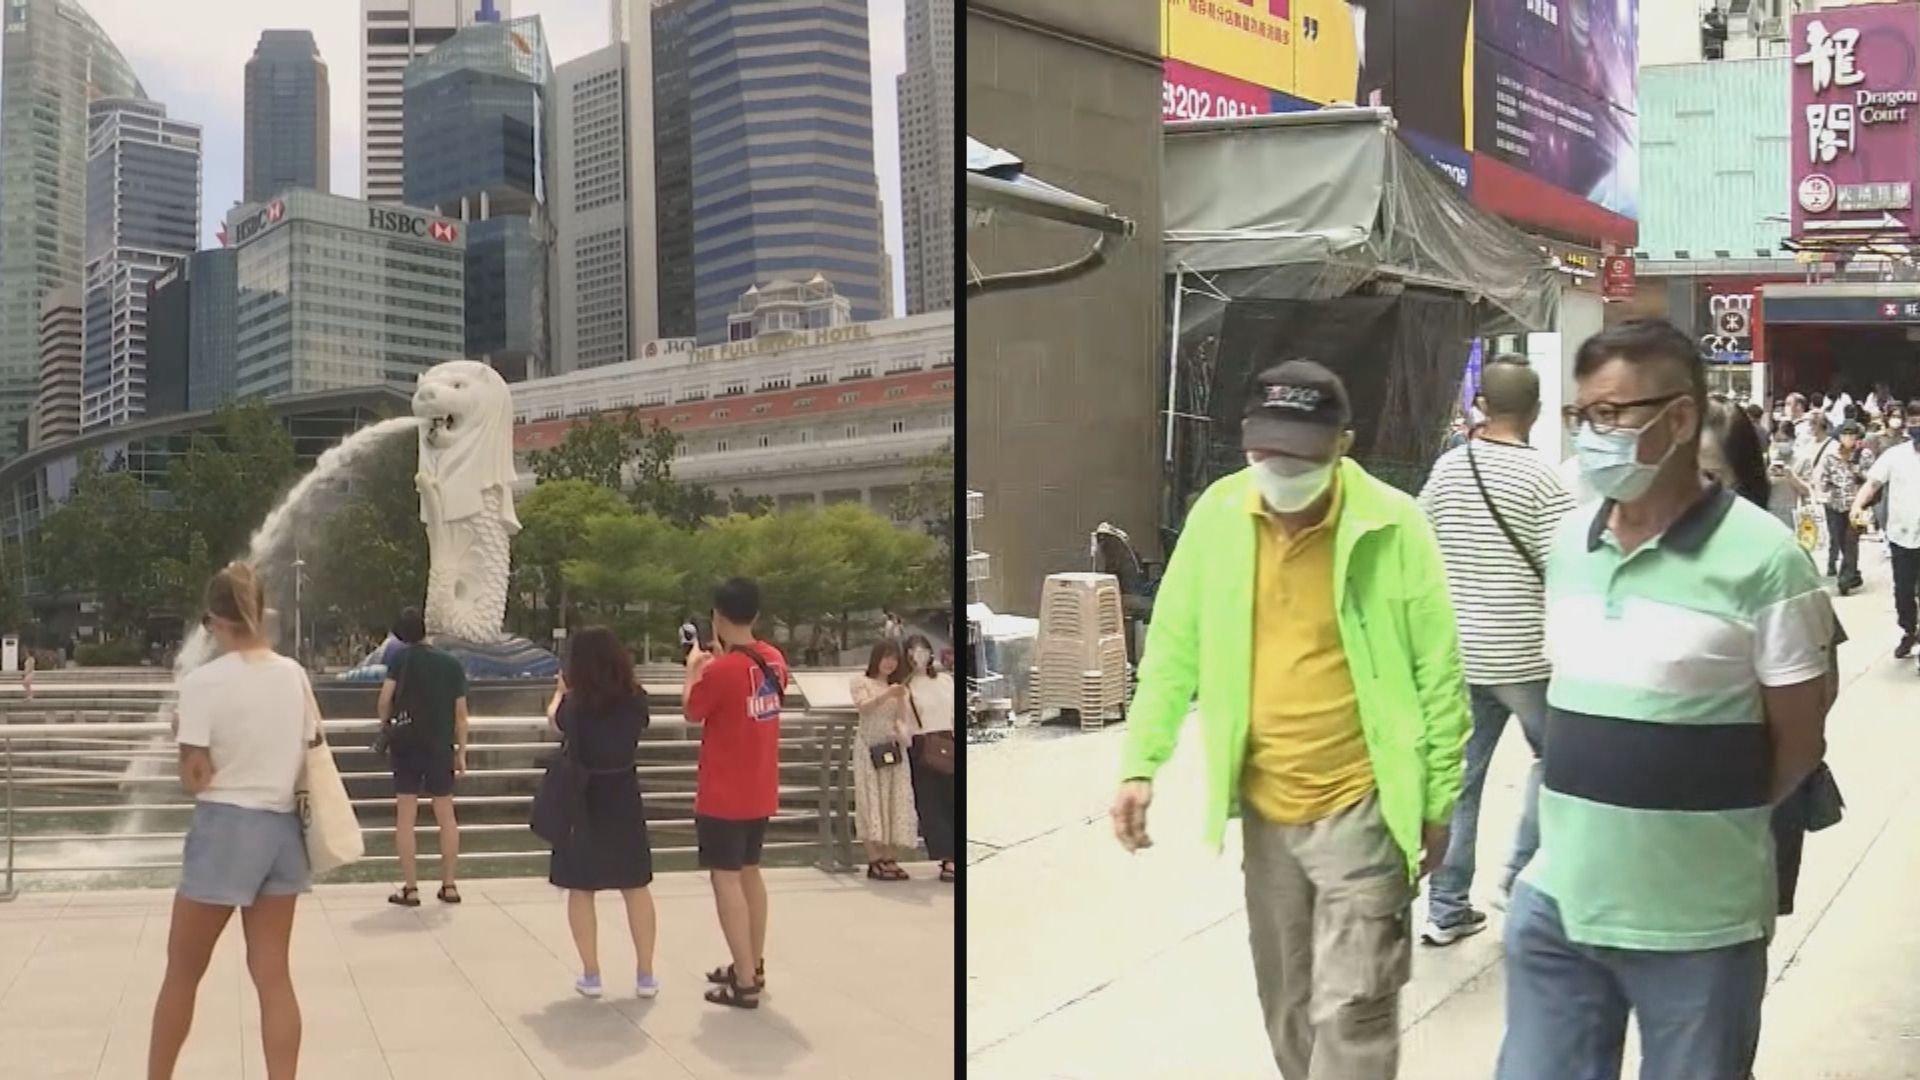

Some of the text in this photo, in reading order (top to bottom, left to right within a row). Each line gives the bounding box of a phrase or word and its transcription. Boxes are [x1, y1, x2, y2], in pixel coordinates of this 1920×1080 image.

[1856, 90, 1917, 107] Dragon
[1860, 106, 1907, 124] Court
[236, 207, 267, 243] HSBC
[368, 207, 426, 237] HSBC
[687, 347, 715, 363] THE
[815, 324, 871, 345] HOTEL
